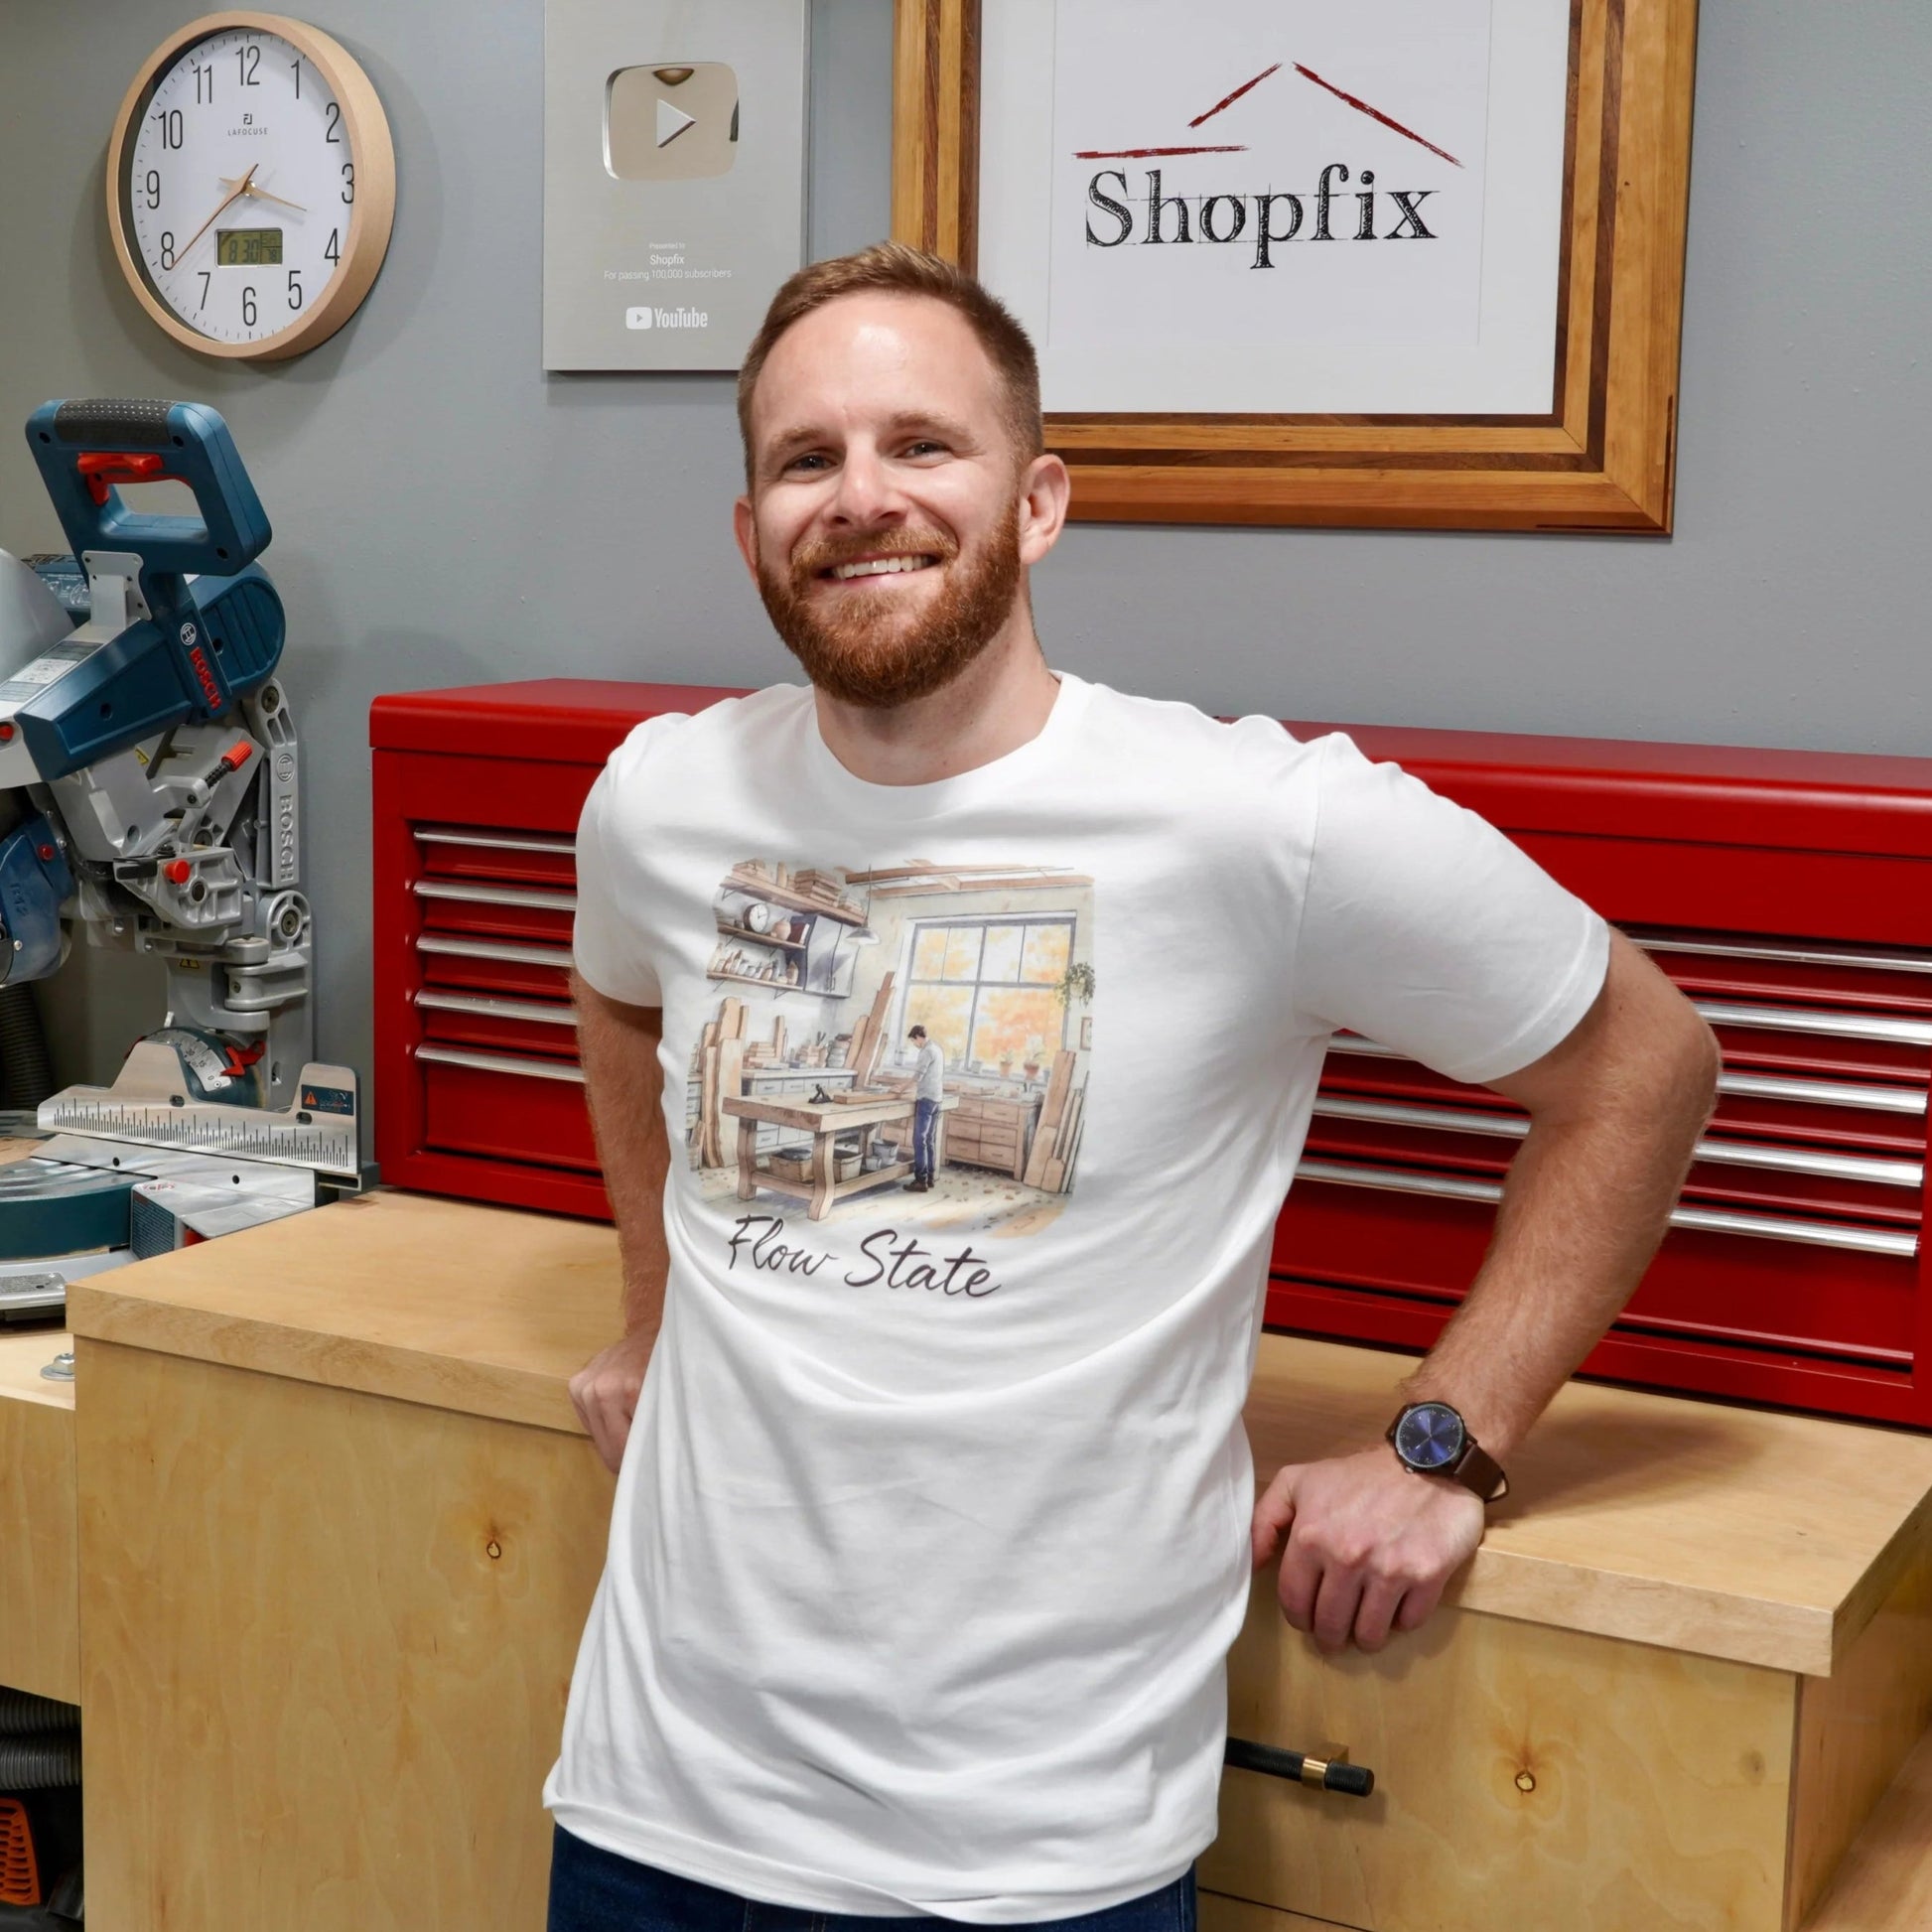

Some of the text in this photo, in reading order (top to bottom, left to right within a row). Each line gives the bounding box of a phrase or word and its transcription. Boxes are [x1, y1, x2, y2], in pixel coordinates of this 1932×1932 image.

[193, 65, 212, 104] 11
[235, 46, 260, 86] 12
[291, 60, 300, 99] 1
[158, 109, 184, 150] 10
[227, 127, 269, 137] LAFOCUSE
[326, 102, 341, 143] 2
[146, 170, 161, 209] 9
[342, 163, 355, 205] 3
[1086, 163, 1440, 270] Shopfix
[161, 231, 176, 271] 8
[324, 227, 341, 268] 4
[649, 253, 685, 267] Shopfix
[198, 272, 211, 311] 7
[288, 270, 302, 310] 5
[604, 268, 732, 282] For passing 100,000 subscribers
[242, 286, 257, 327] 6
[654, 307, 708, 328] YouTube
[189, 646, 222, 710] BOSCH
[279, 794, 294, 883] BOSCH
[728, 1214, 1001, 1298] Flow State
